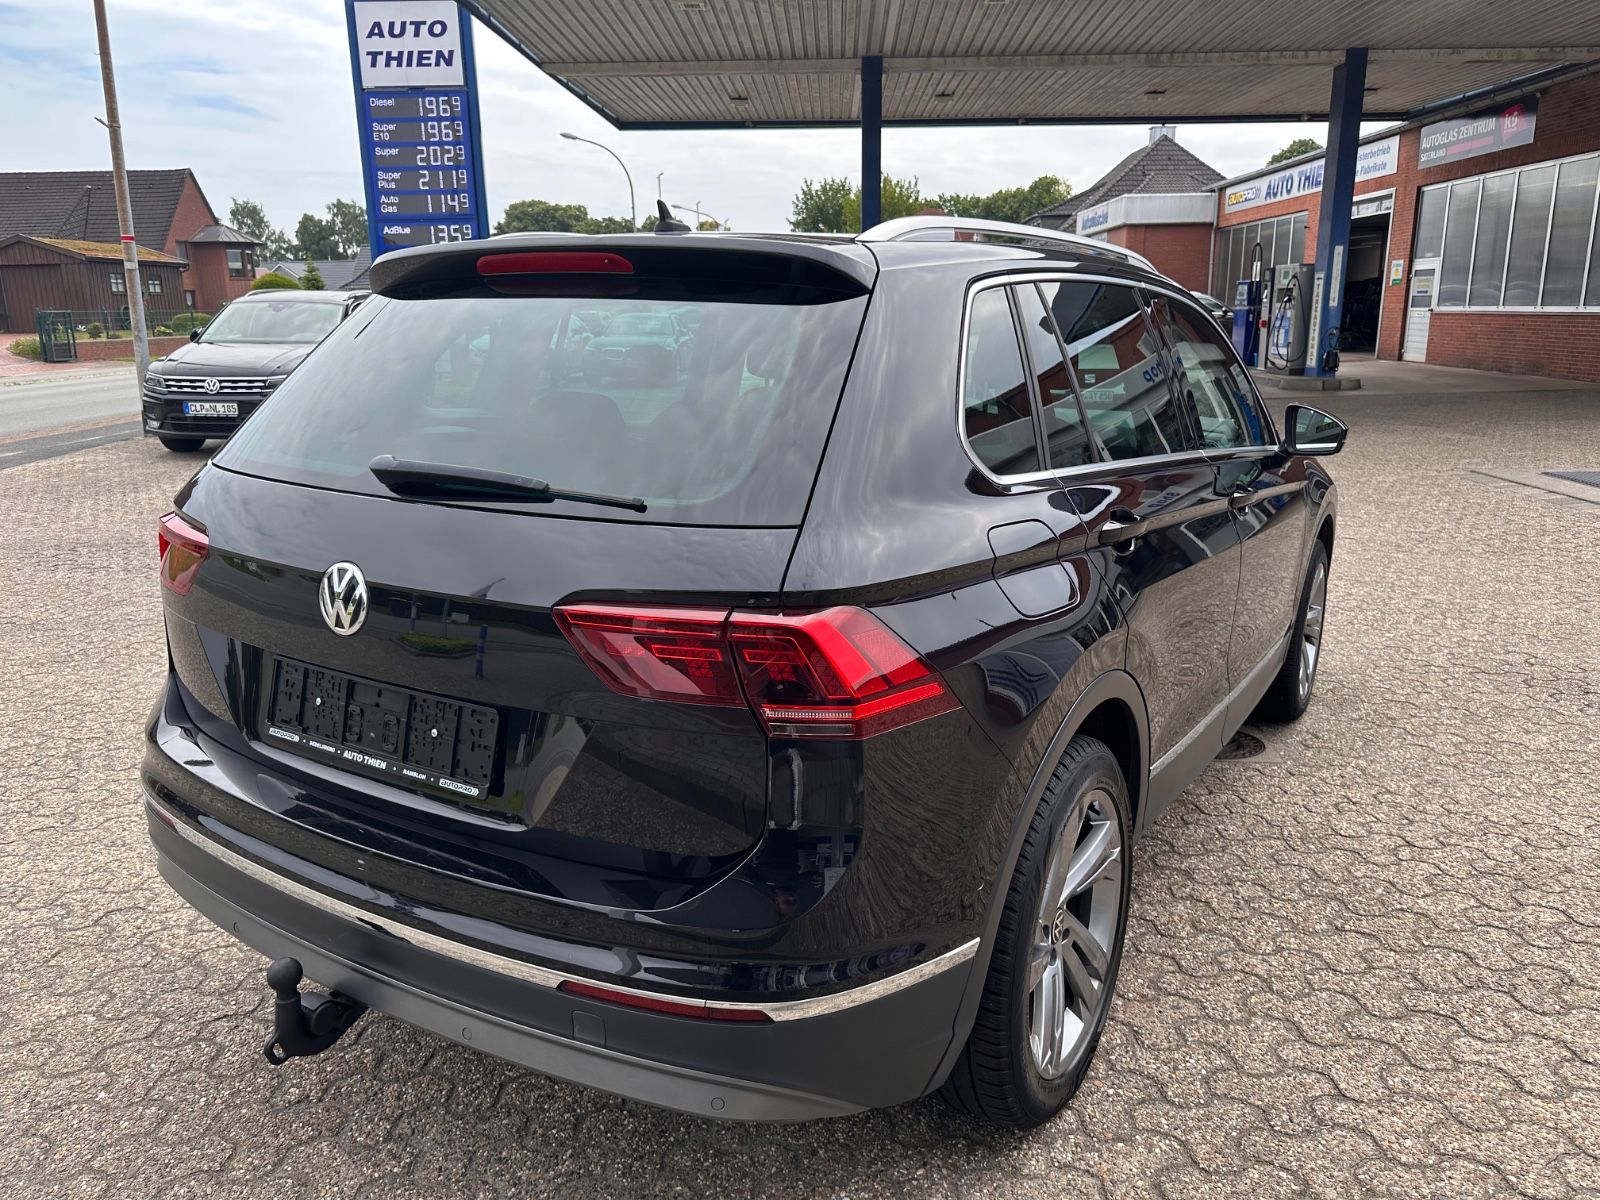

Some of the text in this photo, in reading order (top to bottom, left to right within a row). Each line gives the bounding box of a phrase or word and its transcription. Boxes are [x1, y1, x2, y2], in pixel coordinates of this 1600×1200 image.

[366, 20, 448, 39] AUTO
[366, 50, 454, 68] THIEN
[369, 98, 395, 107] Diesel
[372, 122, 397, 132] Super
[373, 133, 390, 141] E10
[1421, 117, 1497, 150] AUTOGLAS ZENTRUM
[374, 147, 400, 156] Super
[377, 171, 402, 181] Super
[378, 180, 396, 189] Plus
[1264, 173, 1294, 201] AUTO
[1297, 164, 1324, 192] THIE
[380, 195, 399, 203] Auto
[380, 205, 398, 213] Gas
[383, 226, 411, 234] AdBlue
[189, 403, 237, 414] CLP NL 185
[342, 750, 363, 762] AUTO
[363, 755, 387, 770] THIEN
